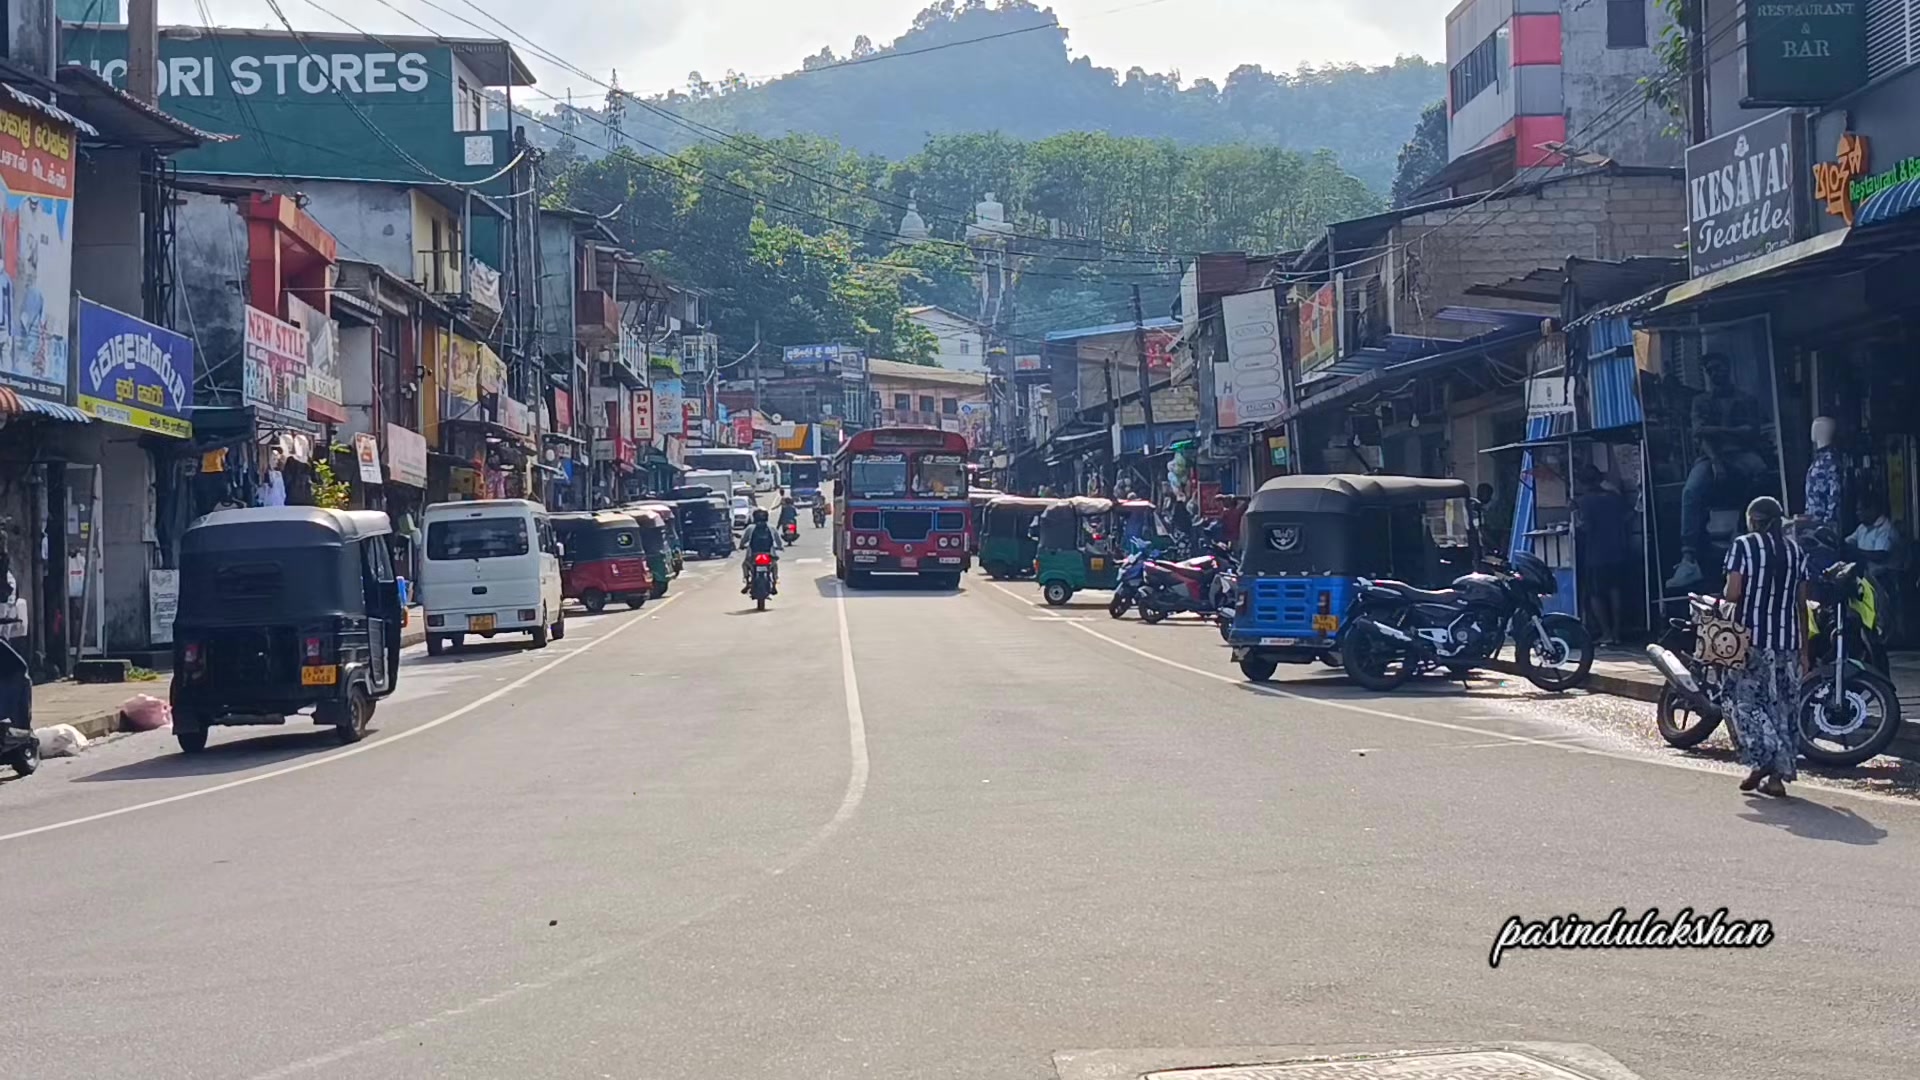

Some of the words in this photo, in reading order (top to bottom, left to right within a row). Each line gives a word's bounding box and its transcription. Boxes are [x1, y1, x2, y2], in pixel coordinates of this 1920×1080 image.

[1758, 3, 1855, 16] RESTAURANT
[1801, 22, 1810, 34] &
[1782, 40, 1830, 57] BAR
[230, 53, 429, 95] STORES
[1849, 162, 1897, 201] Restaurant
[1900, 159, 1908, 182] &
[248, 310, 273, 346] NEW
[276, 323, 305, 359] STYLE
[636, 393, 648, 426] DSI
